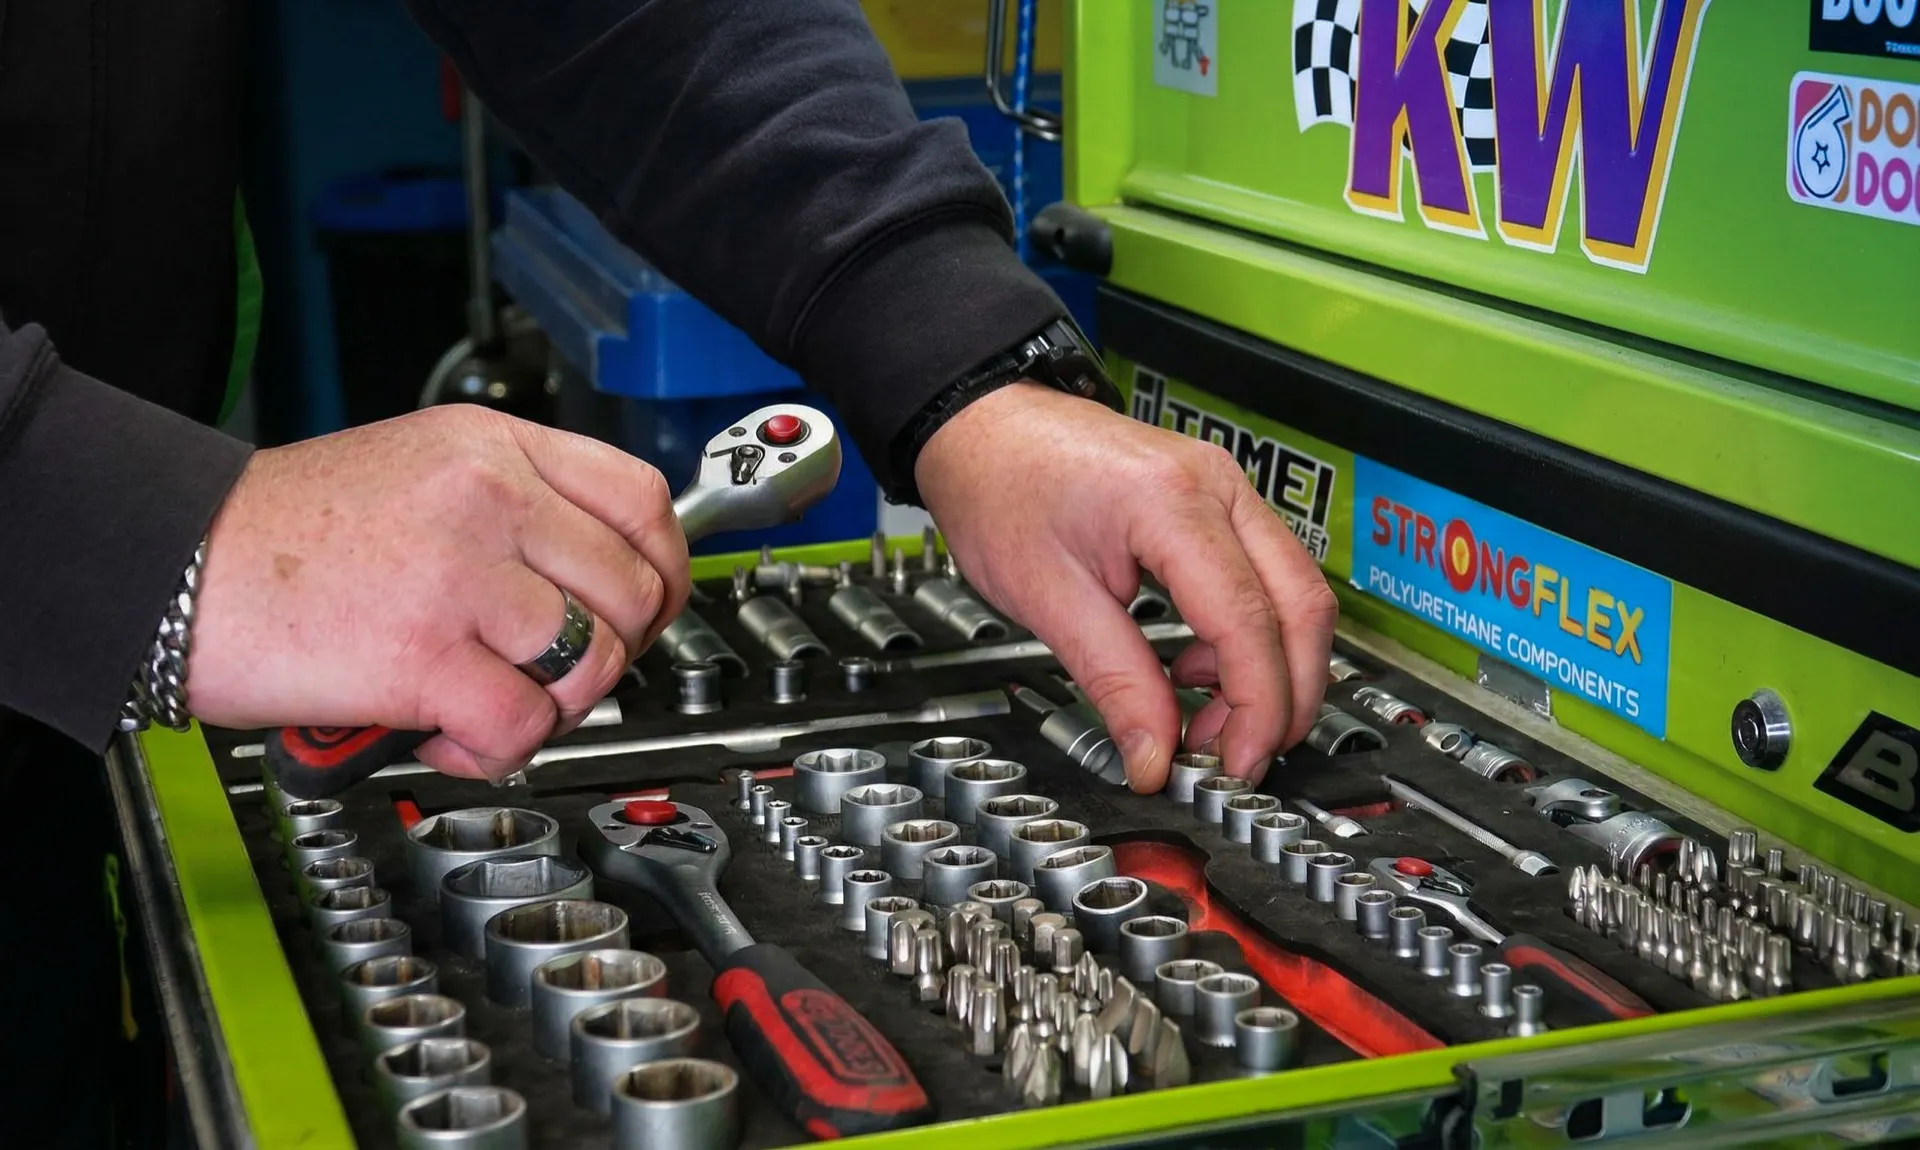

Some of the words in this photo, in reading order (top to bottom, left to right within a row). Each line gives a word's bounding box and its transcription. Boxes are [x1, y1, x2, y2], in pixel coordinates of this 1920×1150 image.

[1343, 0, 1708, 274] KW
[1855, 151, 1920, 216] DO
[1858, 87, 1920, 148] DO
[1369, 565, 1503, 651] POLYURETHANE
[1506, 633, 1641, 718] COMPONENTS
[1371, 495, 1644, 665] STRONGFLEX
